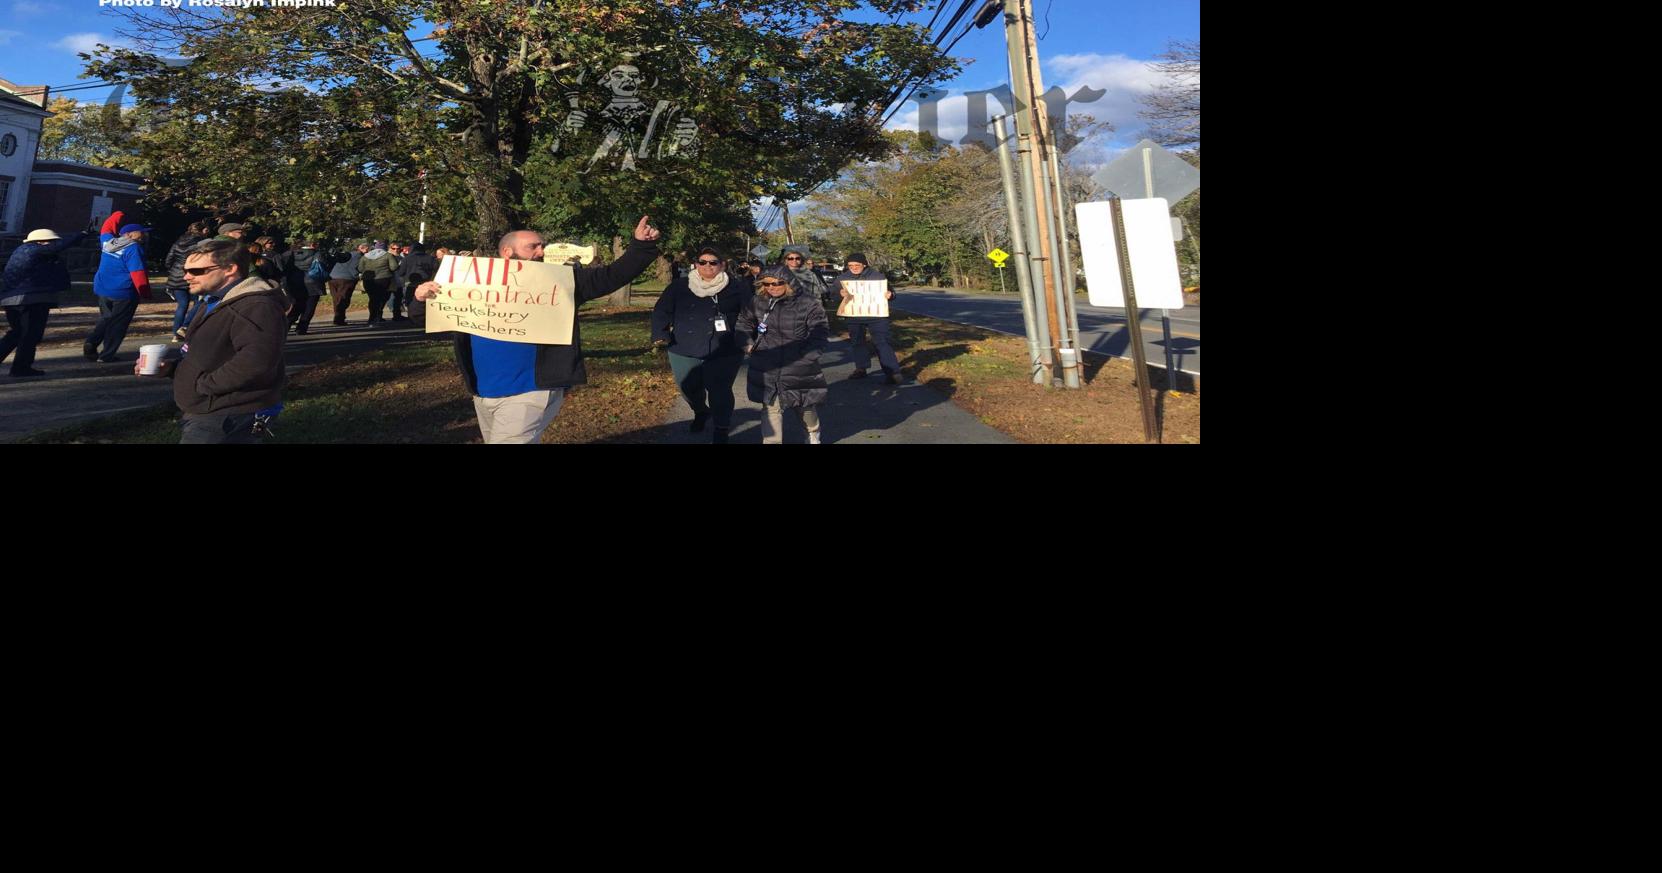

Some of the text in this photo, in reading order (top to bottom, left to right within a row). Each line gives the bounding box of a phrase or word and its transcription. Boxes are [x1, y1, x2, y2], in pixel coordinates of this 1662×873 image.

[448, 256, 524, 286] FAIR
[447, 285, 560, 306] contract
[430, 301, 529, 323] Tewksbury
[446, 314, 526, 336] Teachers
